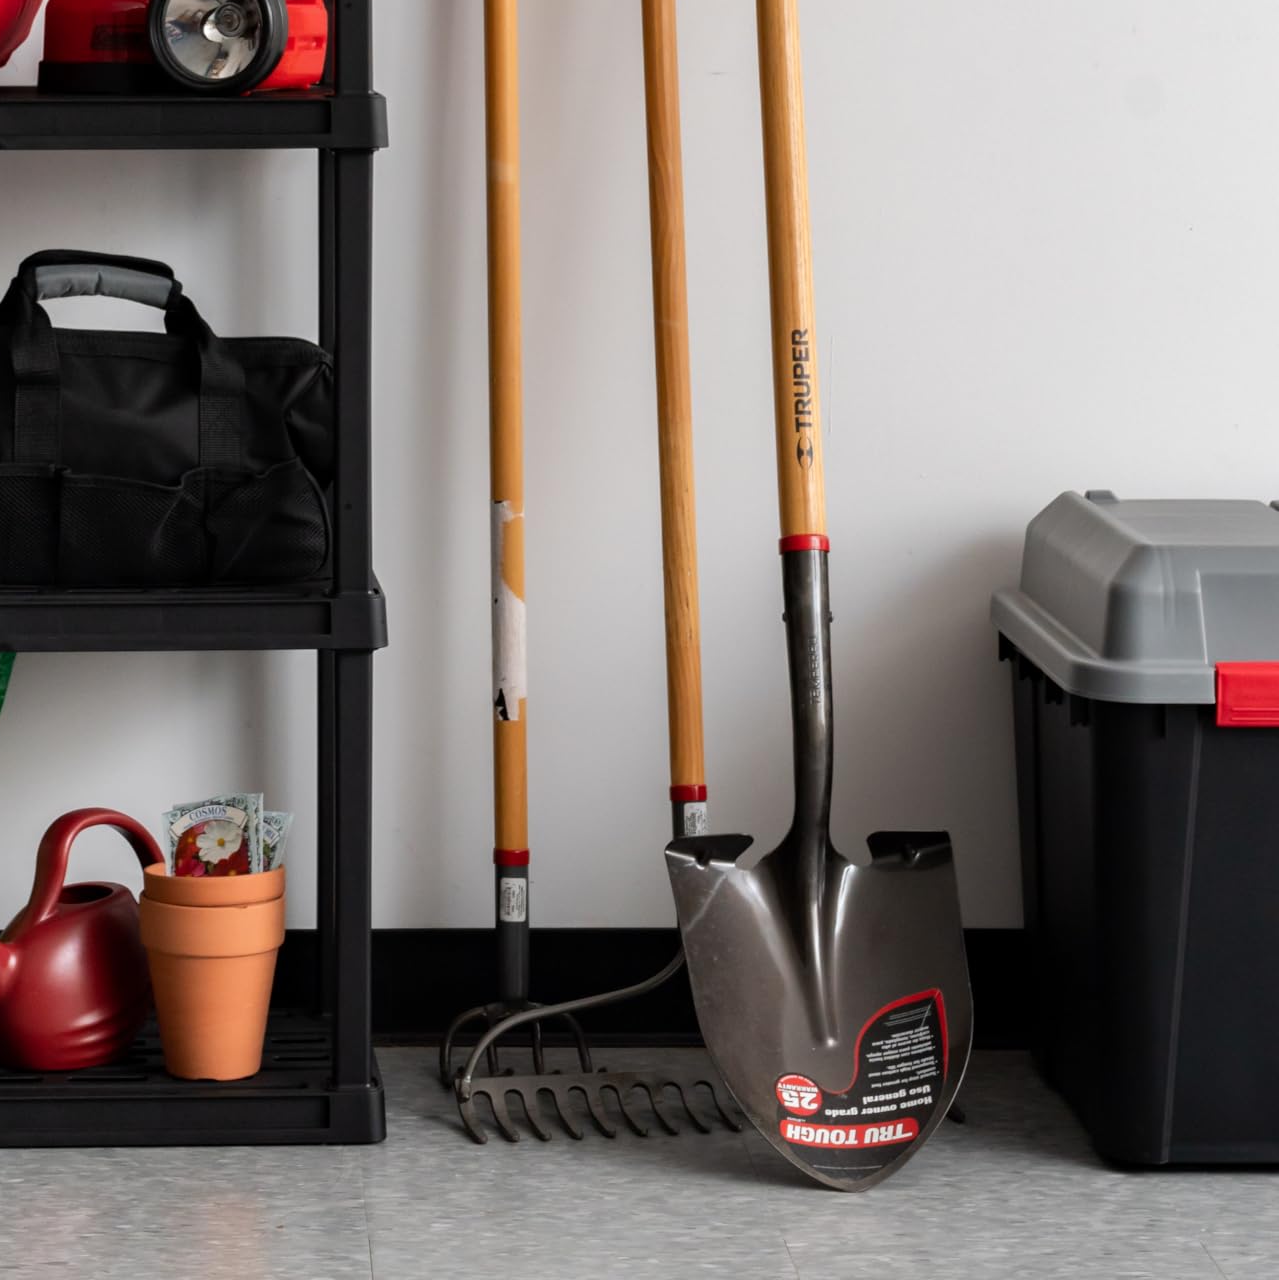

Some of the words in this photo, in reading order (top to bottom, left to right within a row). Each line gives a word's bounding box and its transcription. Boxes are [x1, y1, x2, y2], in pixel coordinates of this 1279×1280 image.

[791, 328, 813, 433] TRUPER
[189, 807, 228, 821] COSMOS
[777, 1082, 819, 1093] WARRANTY
[909, 1084, 932, 1095] Uso
[781, 1091, 819, 1111] 25
[862, 1088, 907, 1106] general
[900, 1096, 933, 1110] Home
[825, 1106, 859, 1118] grade
[860, 1104, 898, 1116] owner
[786, 1124, 858, 1145] TOUGH
[863, 1123, 913, 1143] TRU
